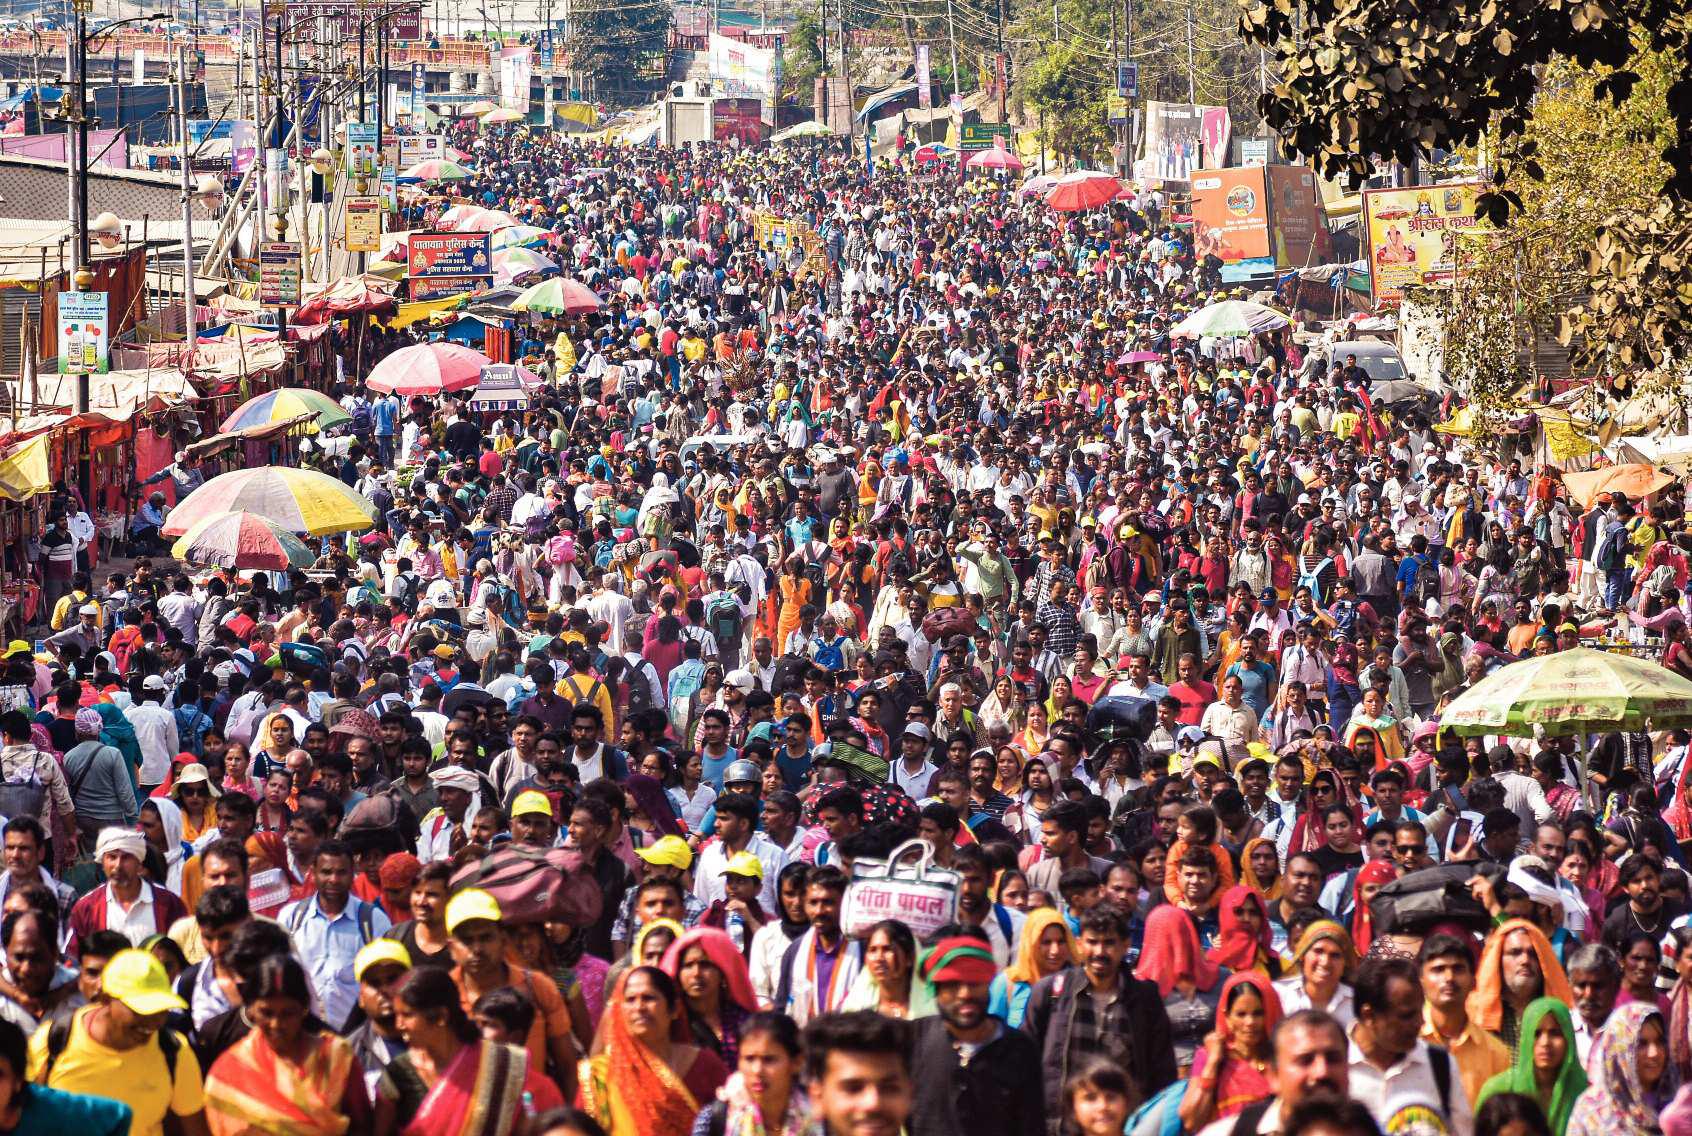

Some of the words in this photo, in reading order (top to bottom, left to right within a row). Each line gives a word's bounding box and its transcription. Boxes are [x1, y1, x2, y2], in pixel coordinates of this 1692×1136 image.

[397, 18, 418, 27] Station
[446, 238, 466, 250] पुलिस
[484, 370, 512, 379] Amul
[898, 893, 946, 916] पायल
